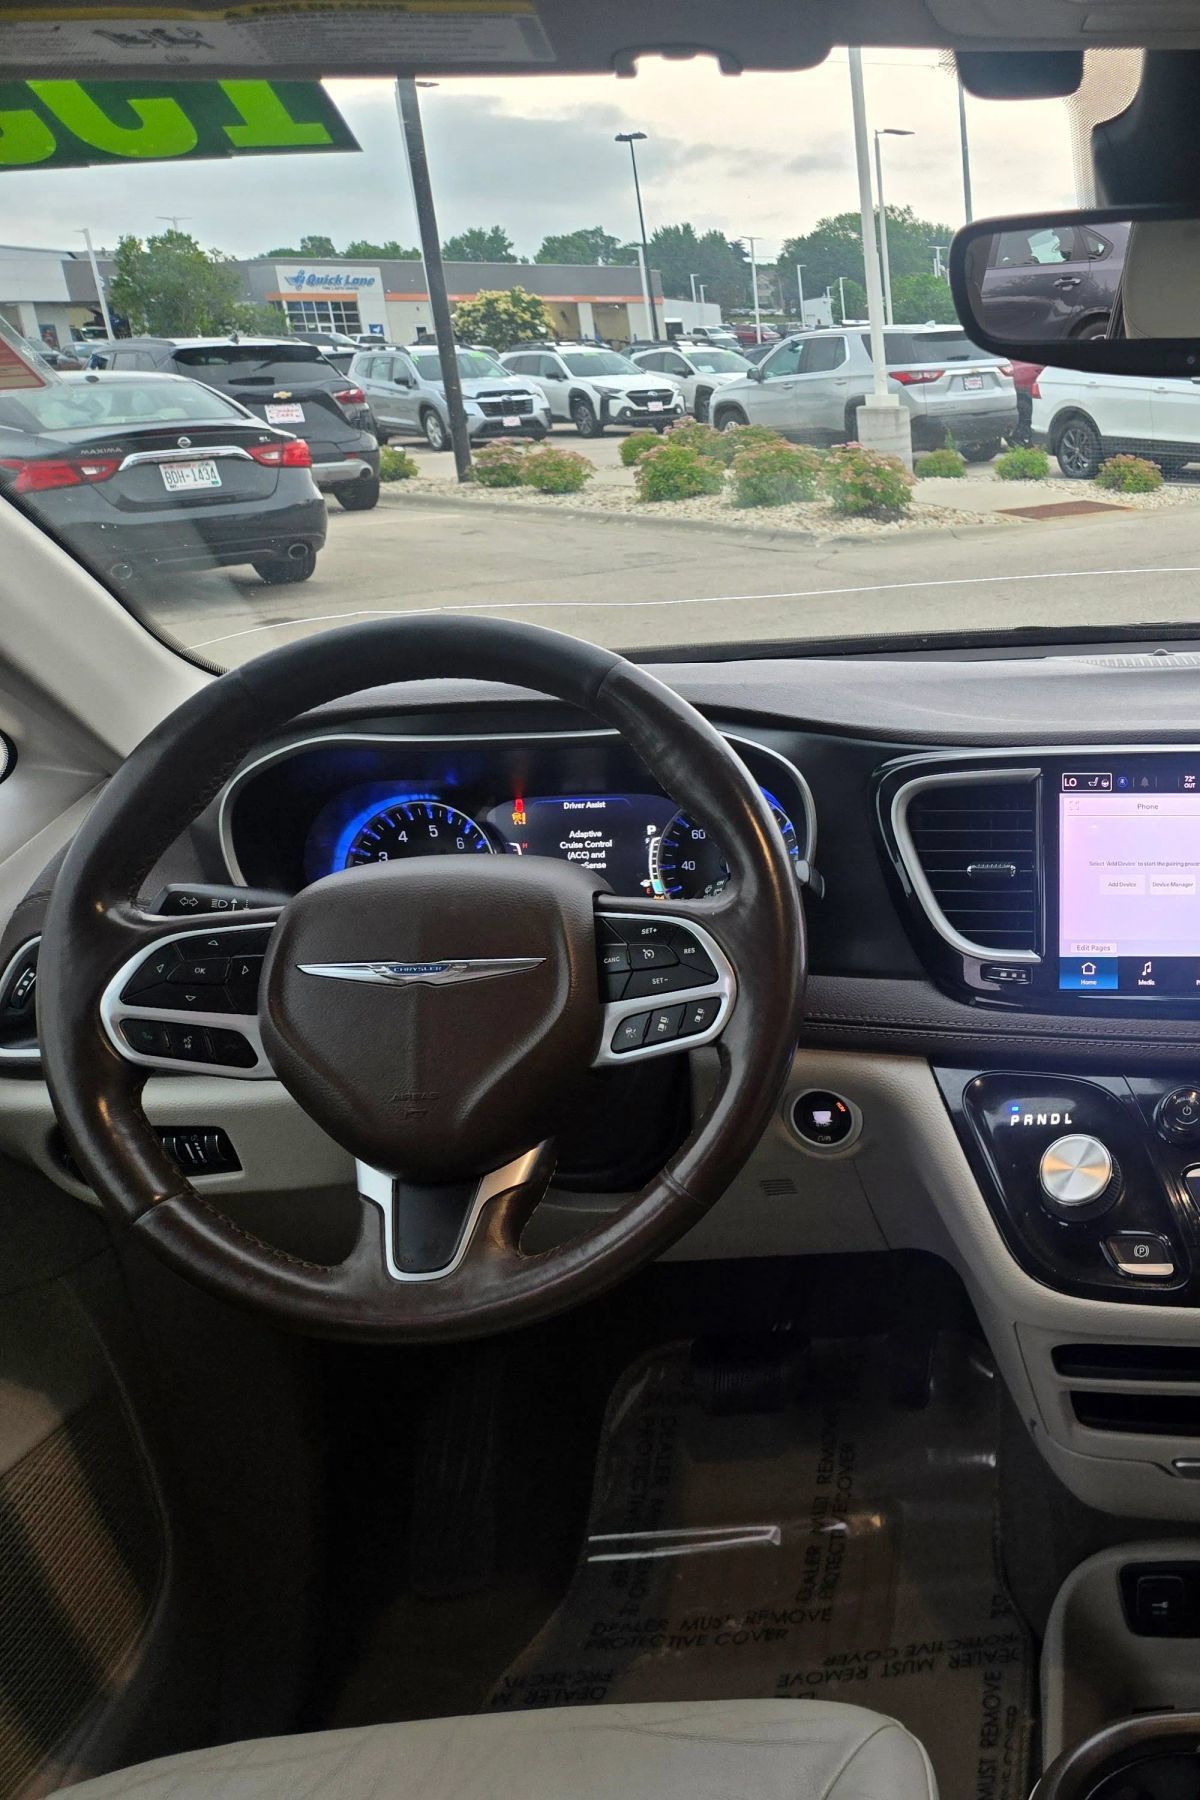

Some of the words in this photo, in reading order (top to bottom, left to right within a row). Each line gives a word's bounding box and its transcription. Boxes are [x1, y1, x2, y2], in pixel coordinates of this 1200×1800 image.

[306, 274, 343, 287] Quick
[345, 274, 375, 287] Lane
[1064, 778, 1077, 787] LO
[564, 802, 584, 810] Driver
[428, 825, 439, 837] 5
[569, 830, 602, 839] Adaptive
[646, 825, 656, 835] P
[692, 830, 706, 840] 60
[398, 831, 408, 843] 4
[456, 837, 465, 849] 6
[585, 840, 613, 848] Control
[567, 851, 589, 860] (ACC)
[591, 851, 606, 859] and
[681, 861, 696, 871] 40
[1091, 945, 1110, 953] Pages
[604, 956, 620, 964] CANC
[592, 1618, 668, 1636] DEALER
[743, 1607, 832, 1625] REMOVE
[585, 1634, 707, 1650] PROTECTIVE
[715, 1628, 788, 1645] COVER
[824, 1649, 900, 1666] COVER
[880, 1658, 936, 1678] MUST
[777, 1667, 868, 1688] REMOVE
[980, 1671, 1001, 1748] REMOVE
